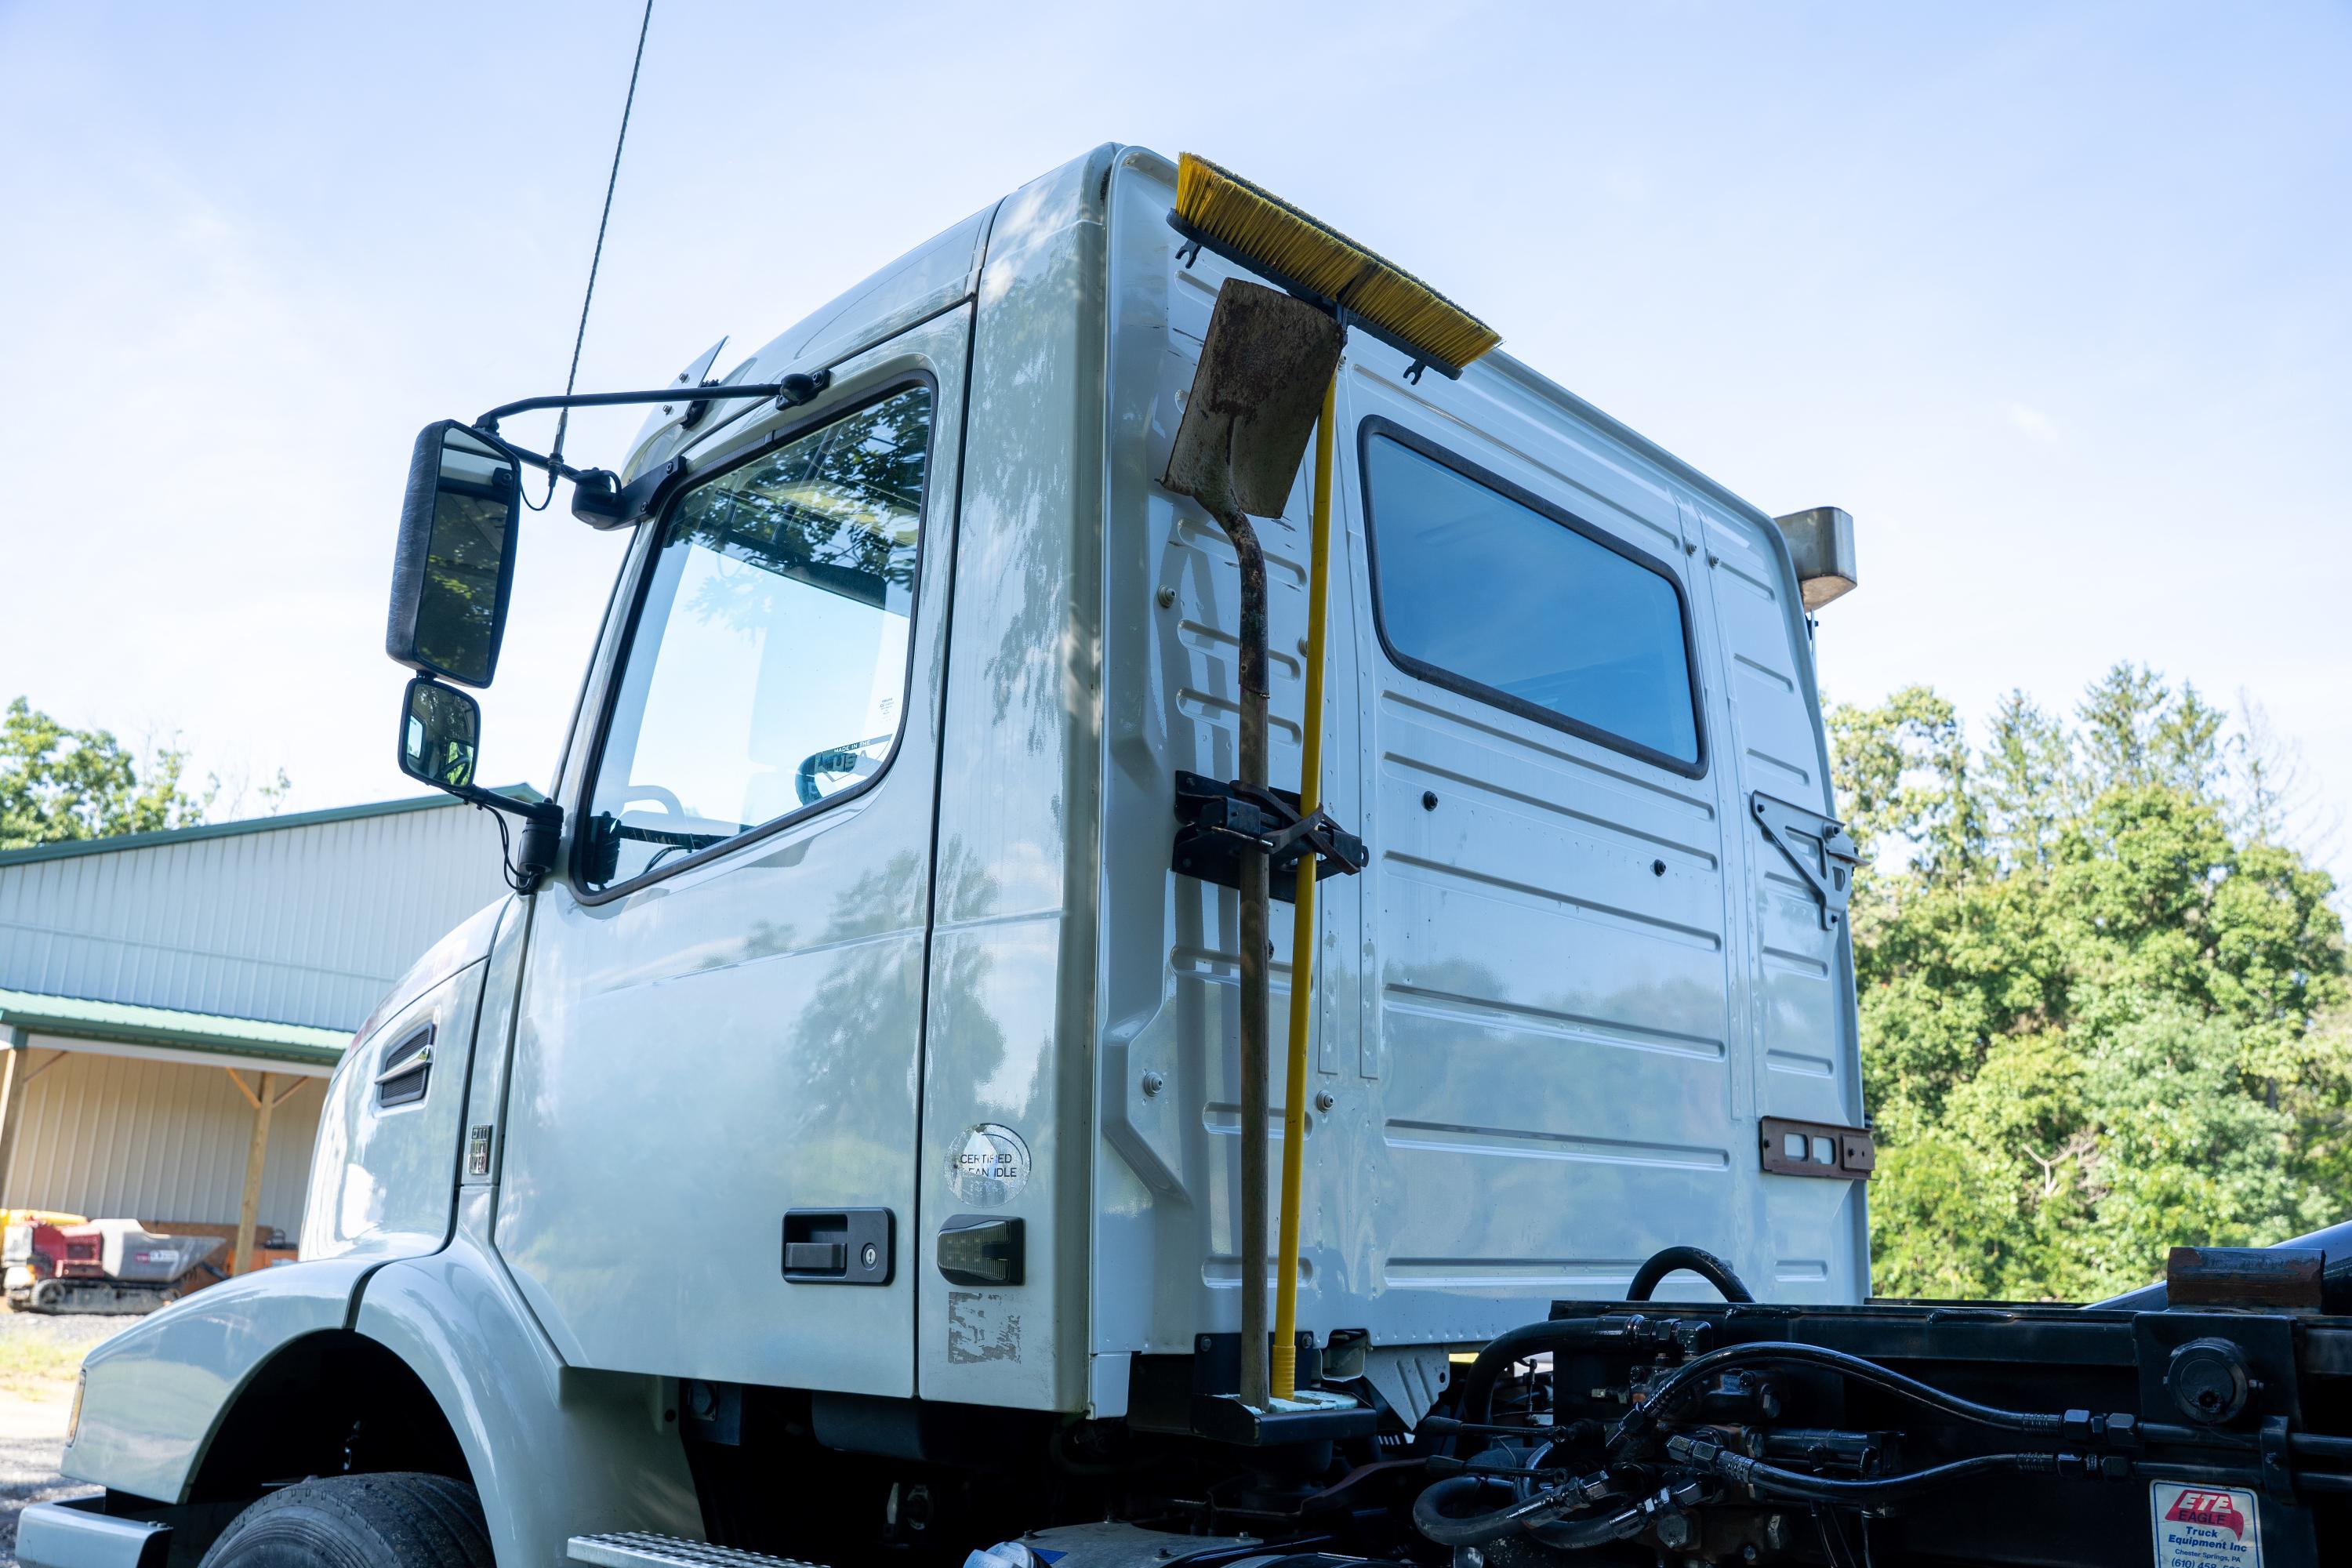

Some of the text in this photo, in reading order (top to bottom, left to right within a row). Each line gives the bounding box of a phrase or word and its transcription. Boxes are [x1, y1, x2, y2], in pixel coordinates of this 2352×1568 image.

[833, 750, 868, 771] USA
[994, 1167, 1017, 1178] IDLE
[2178, 1493, 2232, 1514] ETE
[2178, 1510, 2226, 1526] EAGLE
[2186, 1526, 2219, 1538] Truck
[2168, 1534, 2247, 1552] Equipment Inc
[2175, 1548, 2201, 1557] Chester
[2171, 1558, 2195, 1568] (610)
